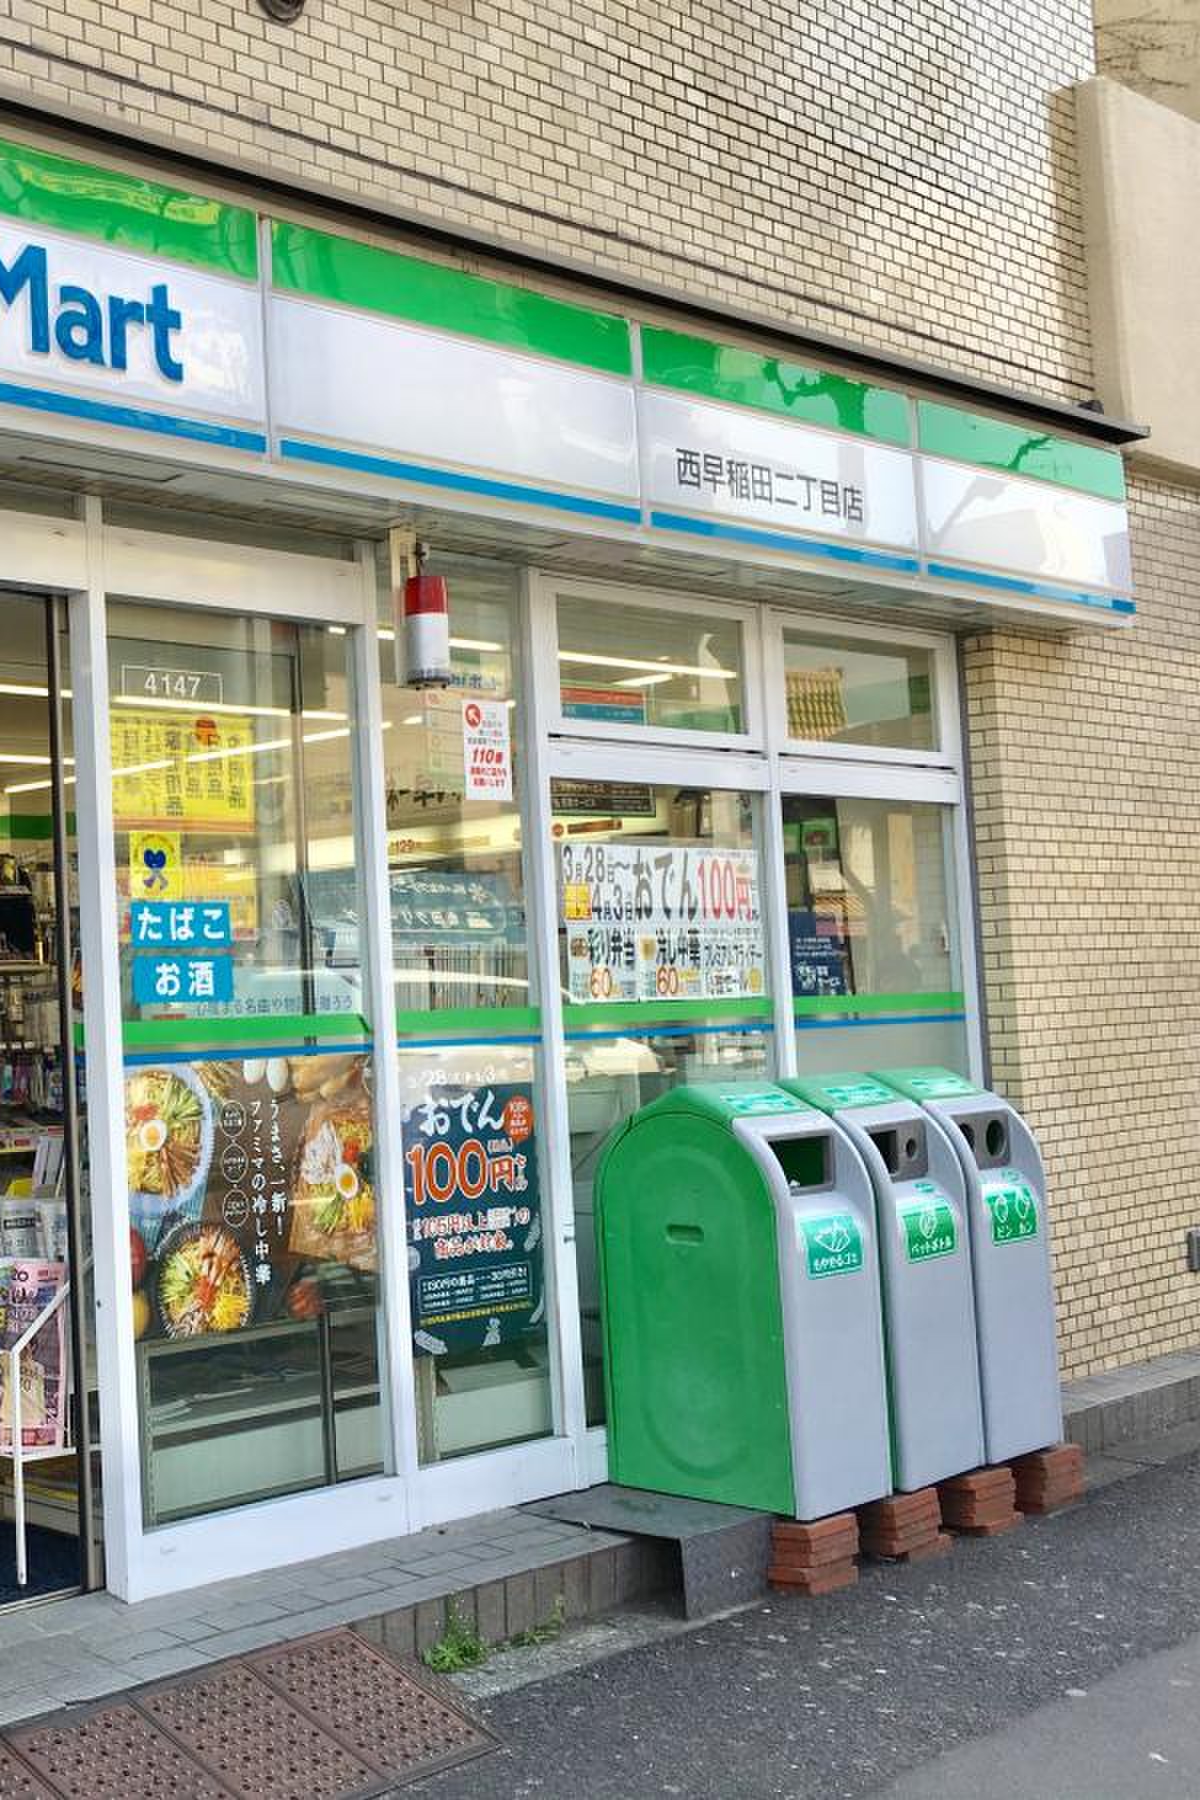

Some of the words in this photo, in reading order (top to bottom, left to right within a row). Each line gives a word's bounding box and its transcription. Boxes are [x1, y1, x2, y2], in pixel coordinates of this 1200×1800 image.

[676, 448, 865, 522] 西早稲田二丁目店
[144, 673, 201, 698] 4147
[632, 847, 698, 921] おでん
[138, 907, 225, 941] たばこ
[155, 961, 216, 998] お酒
[416, 1088, 506, 1137] おでん
[251, 1100, 272, 1286] ファミマの冷し中華
